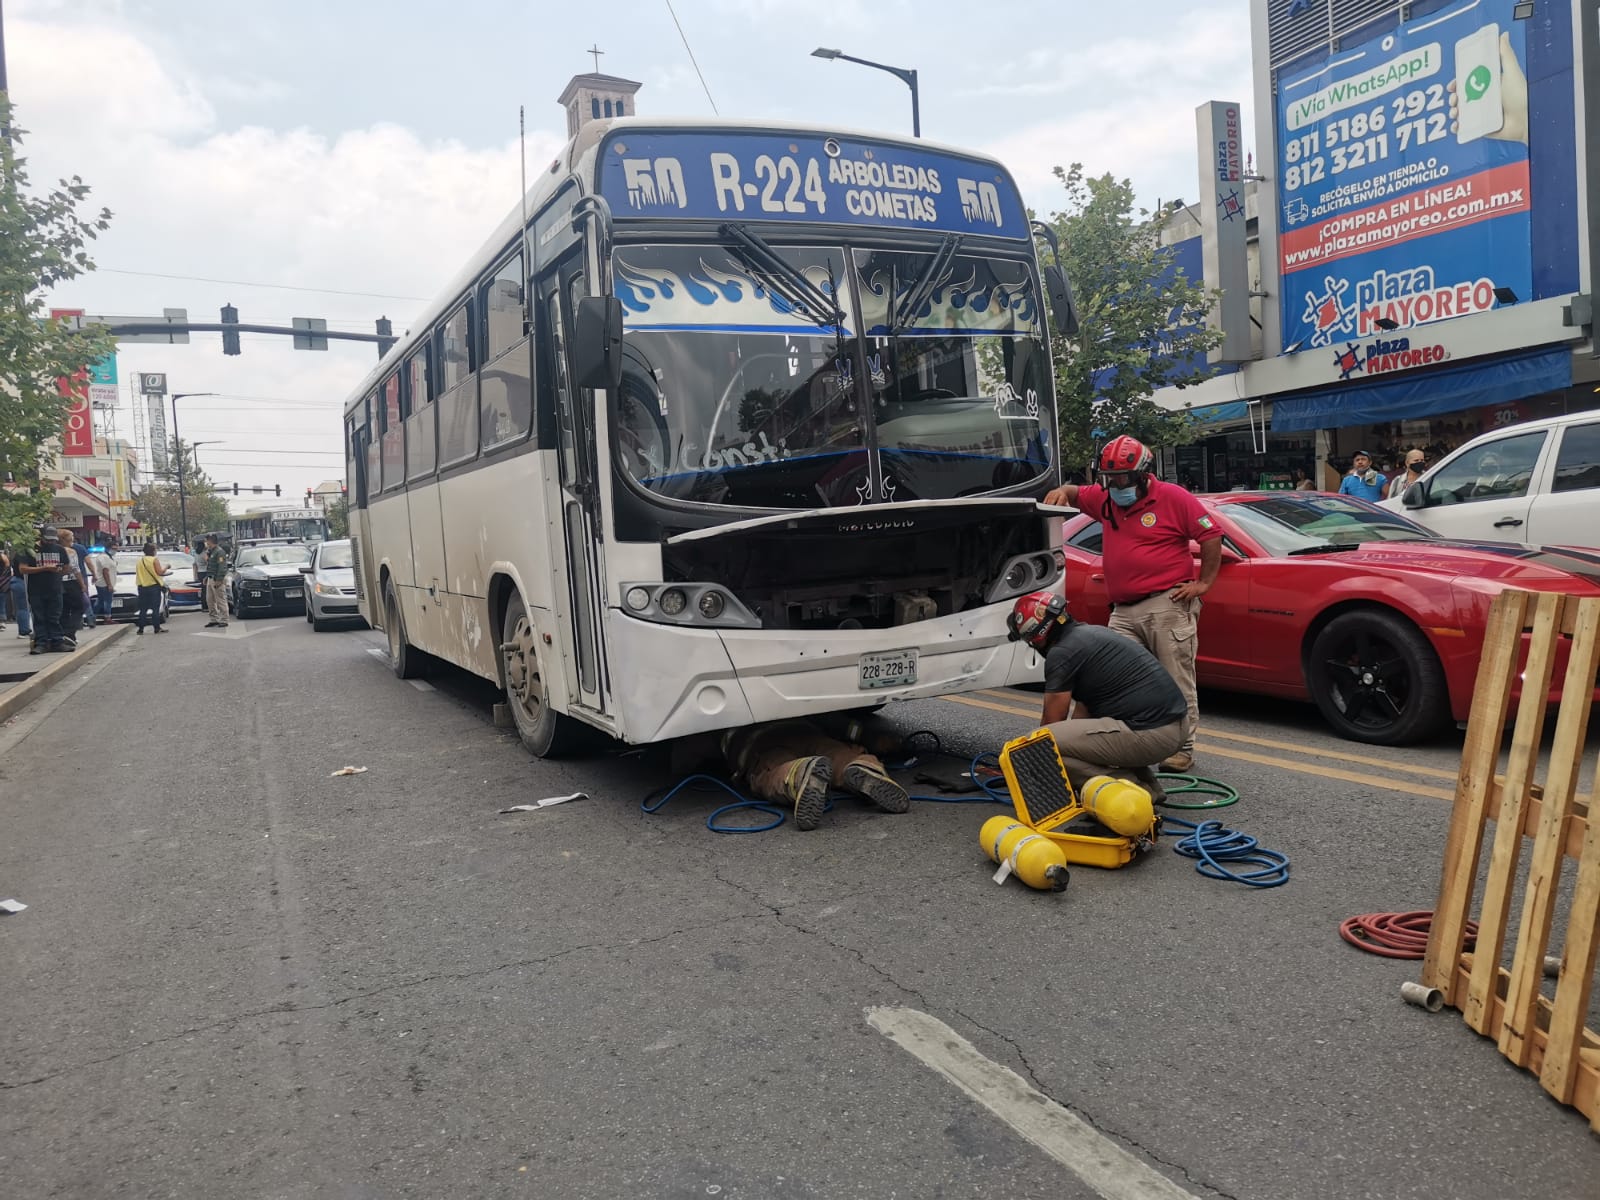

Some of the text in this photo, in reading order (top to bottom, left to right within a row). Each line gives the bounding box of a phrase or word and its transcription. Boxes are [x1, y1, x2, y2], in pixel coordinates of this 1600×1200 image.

[1381, 35, 1394, 51] O
[1328, 51, 1429, 105] WhatsApp!
[1226, 108, 1239, 182] MAYOREO
[1286, 83, 1444, 163] 811 5186 292
[1217, 141, 1229, 182] plaza
[1285, 112, 1447, 191] 812 3211 712
[710, 152, 826, 214] R-224
[829, 158, 941, 195] ARBOLEDAS
[1320, 157, 1437, 203] RECÓGELO EN TIENDA O
[845, 190, 937, 222] COMETAS
[1312, 194, 1352, 218] SOLICITA
[1353, 184, 1385, 204] ENVÍO
[1386, 184, 1394, 194] A
[1319, 181, 1472, 242] ¡COMPRA EN LÍNEA!
[1285, 188, 1523, 265] www.plazamayoreo.com.mx
[1359, 268, 1432, 312] plaza
[1359, 281, 1493, 334] MAYOREO
[1367, 338, 1409, 357] plaza
[1367, 345, 1445, 374] MAYOREO
[863, 660, 915, 680] 228-228-R
